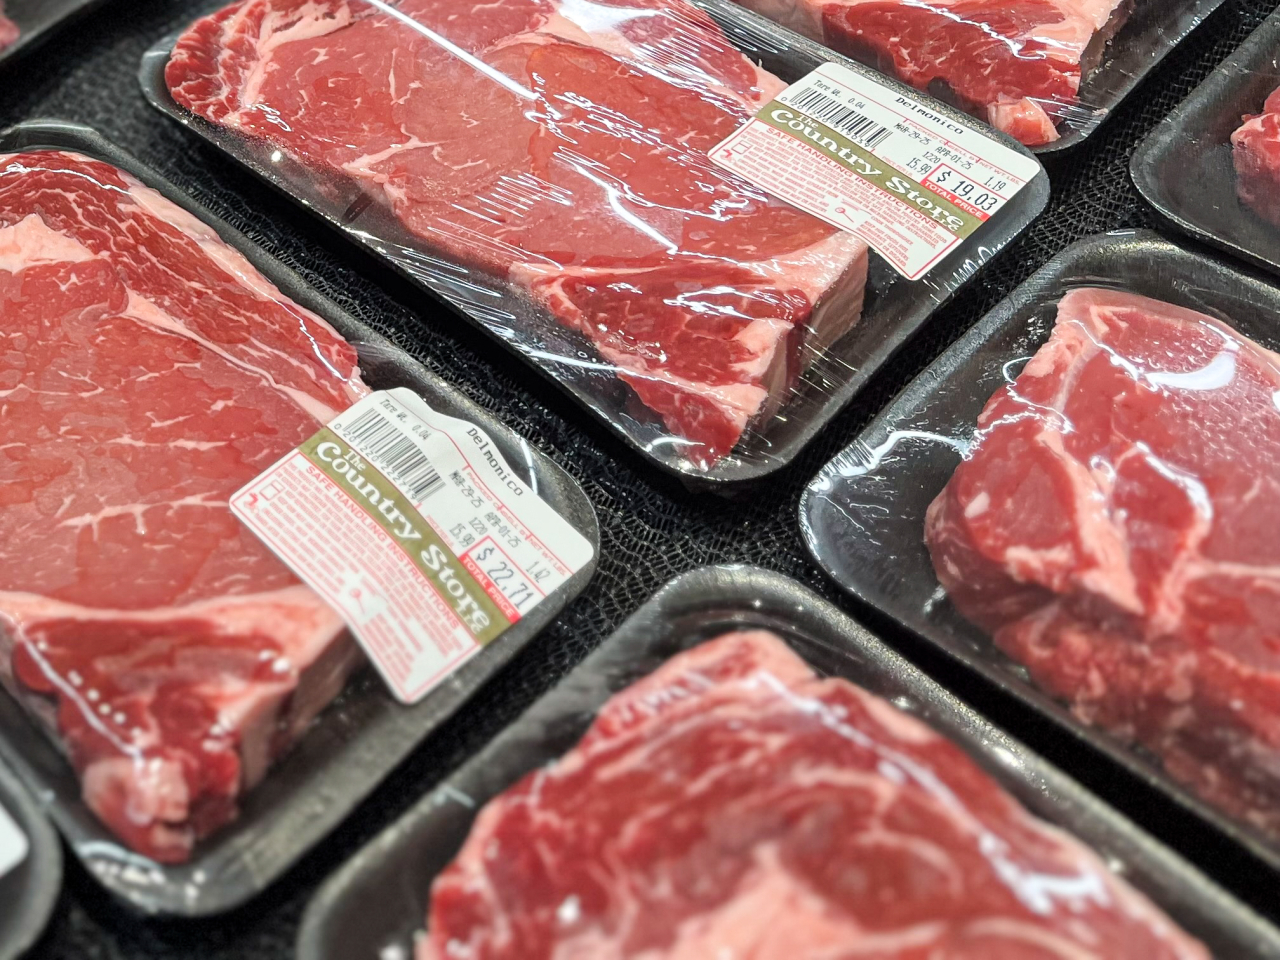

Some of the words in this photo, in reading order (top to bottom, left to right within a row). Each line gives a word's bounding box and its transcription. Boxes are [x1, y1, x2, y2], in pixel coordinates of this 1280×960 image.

[812, 79, 833, 91] Tare
[829, 88, 845, 98] Wt.
[846, 97, 866, 109] 0.04
[795, 113, 820, 128] The
[894, 97, 964, 134] Delmonico
[767, 107, 883, 179] Country
[883, 175, 966, 229] Store
[893, 122, 932, 145] MAR-29-25
[933, 145, 974, 169] APR-01-25
[982, 175, 1007, 192] 1.19
[903, 156, 933, 175] 15.99
[921, 151, 942, 164] 1220
[978, 161, 992, 169] NET
[765, 127, 796, 144] SAFE
[795, 143, 855, 177] HANDLING
[853, 176, 939, 229] INSTRUCTIONS
[933, 169, 953, 183] $
[948, 179, 999, 211] 19.03
[922, 181, 954, 200] TOTAL
[953, 198, 983, 217] PRICE
[928, 212, 960, 232] LLC
[378, 398, 398, 413] Tare
[410, 423, 432, 441] 0.04
[341, 448, 369, 472] The
[465, 426, 524, 497] Delmonico
[312, 437, 423, 546] Country
[417, 542, 495, 631] Store
[447, 469, 486, 509] MAR-29-25
[482, 510, 522, 548] APR-01-25
[523, 560, 552, 584] 1.42
[449, 522, 476, 548] 15.99
[466, 516, 489, 536] 1220
[304, 464, 335, 491] SAFE
[332, 490, 387, 542] HANDLING
[384, 541, 461, 630] INSTRUCTIONS
[474, 544, 497, 563] $
[459, 556, 491, 588] TOTAL
[486, 586, 516, 617] PRICE
[485, 560, 537, 609] 22.71
[452, 604, 482, 635] LLC
